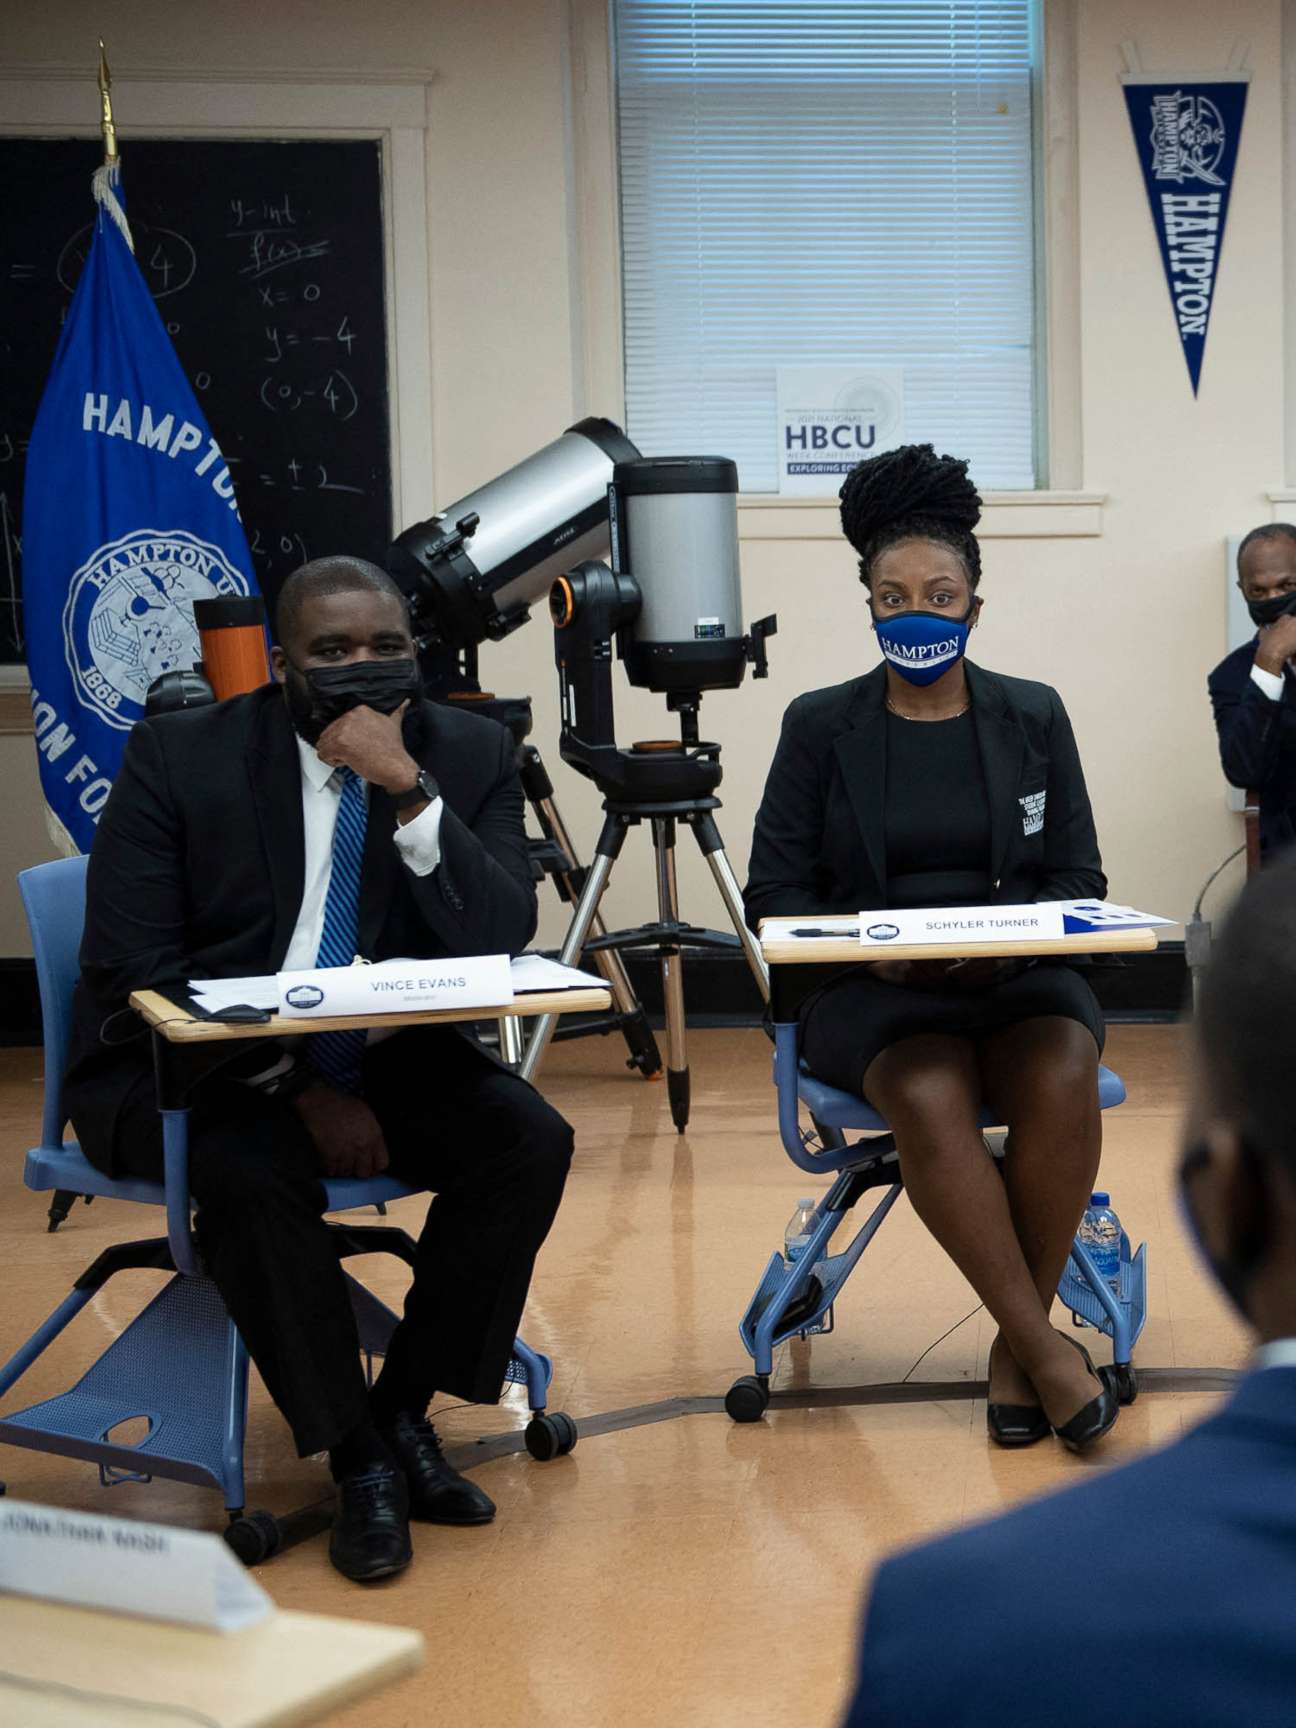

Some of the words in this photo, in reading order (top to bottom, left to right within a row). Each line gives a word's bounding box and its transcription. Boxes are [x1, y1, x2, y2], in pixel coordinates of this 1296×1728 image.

[1161, 192, 1222, 336] HAMPTON
[785, 425, 876, 450] HBCU
[82, 392, 242, 525] HAMPTO
[789, 463, 840, 473] EXPLORING
[87, 544, 215, 590] HAMPTON
[881, 635, 960, 660] HAMPTON
[82, 665, 123, 709] 1868
[65, 754, 113, 825] FO
[925, 918, 985, 931] SCHYLER
[988, 916, 1040, 929] TURNER
[369, 978, 415, 992] VINCE
[418, 976, 467, 990] EVANS
